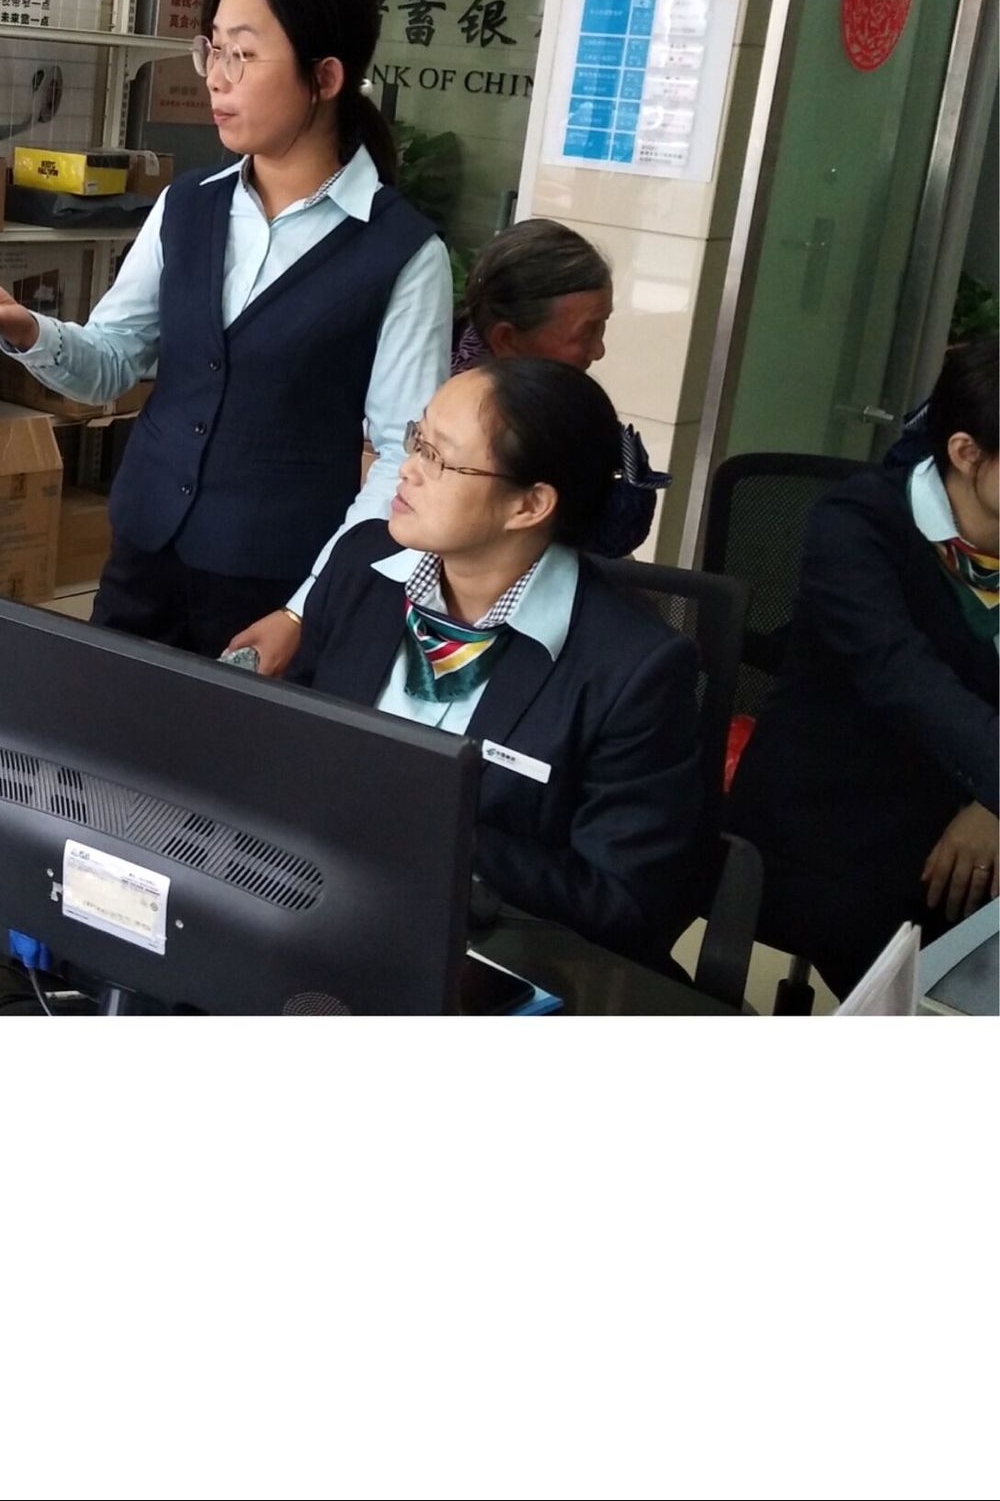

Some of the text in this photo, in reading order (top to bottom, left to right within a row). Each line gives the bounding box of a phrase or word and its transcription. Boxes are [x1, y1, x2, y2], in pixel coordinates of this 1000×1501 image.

[371, 63, 535, 97] NK OF CHIN
